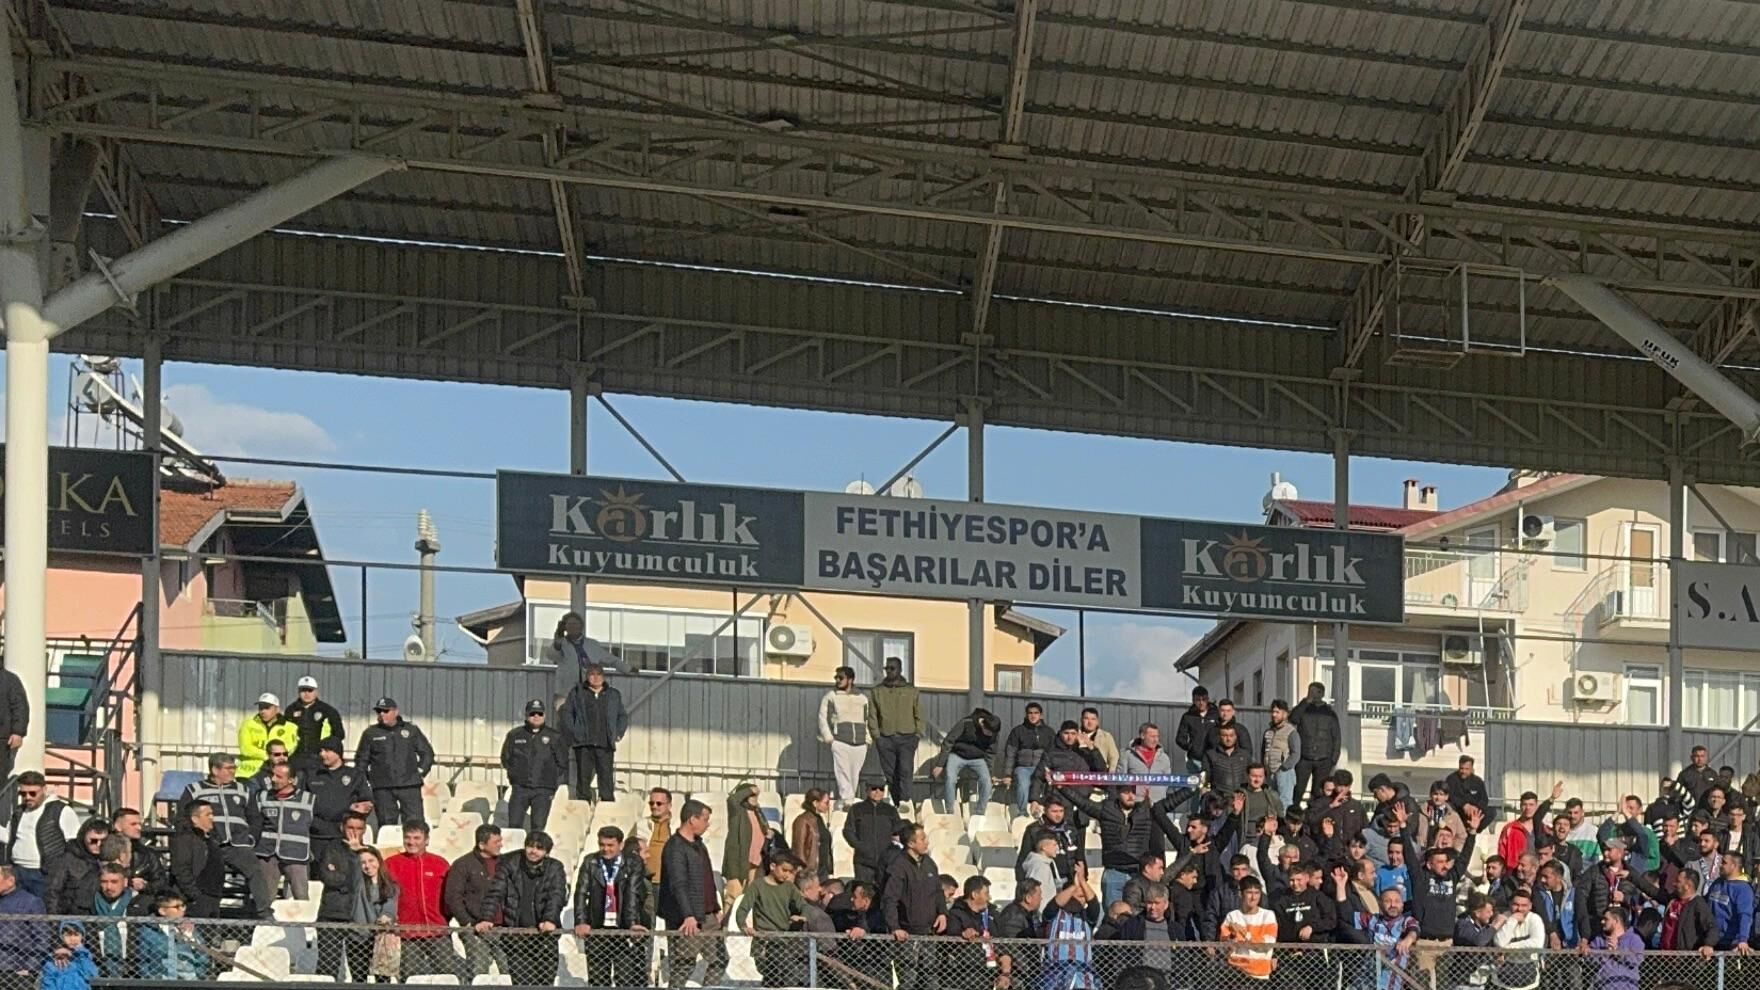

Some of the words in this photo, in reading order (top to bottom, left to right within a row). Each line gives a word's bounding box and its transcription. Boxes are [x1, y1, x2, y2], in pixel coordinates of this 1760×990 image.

[60, 519, 111, 538] ELS
[549, 484, 759, 545] Karlık
[836, 505, 1110, 552] FETHİYESPOR'A
[548, 543, 759, 577] Kuyumculuk
[818, 550, 1017, 589] BAŞARILAR
[1028, 558, 1127, 597] DİLER
[1182, 528, 1366, 585] Karlık
[1182, 585, 1366, 614] Kuyumculuk
